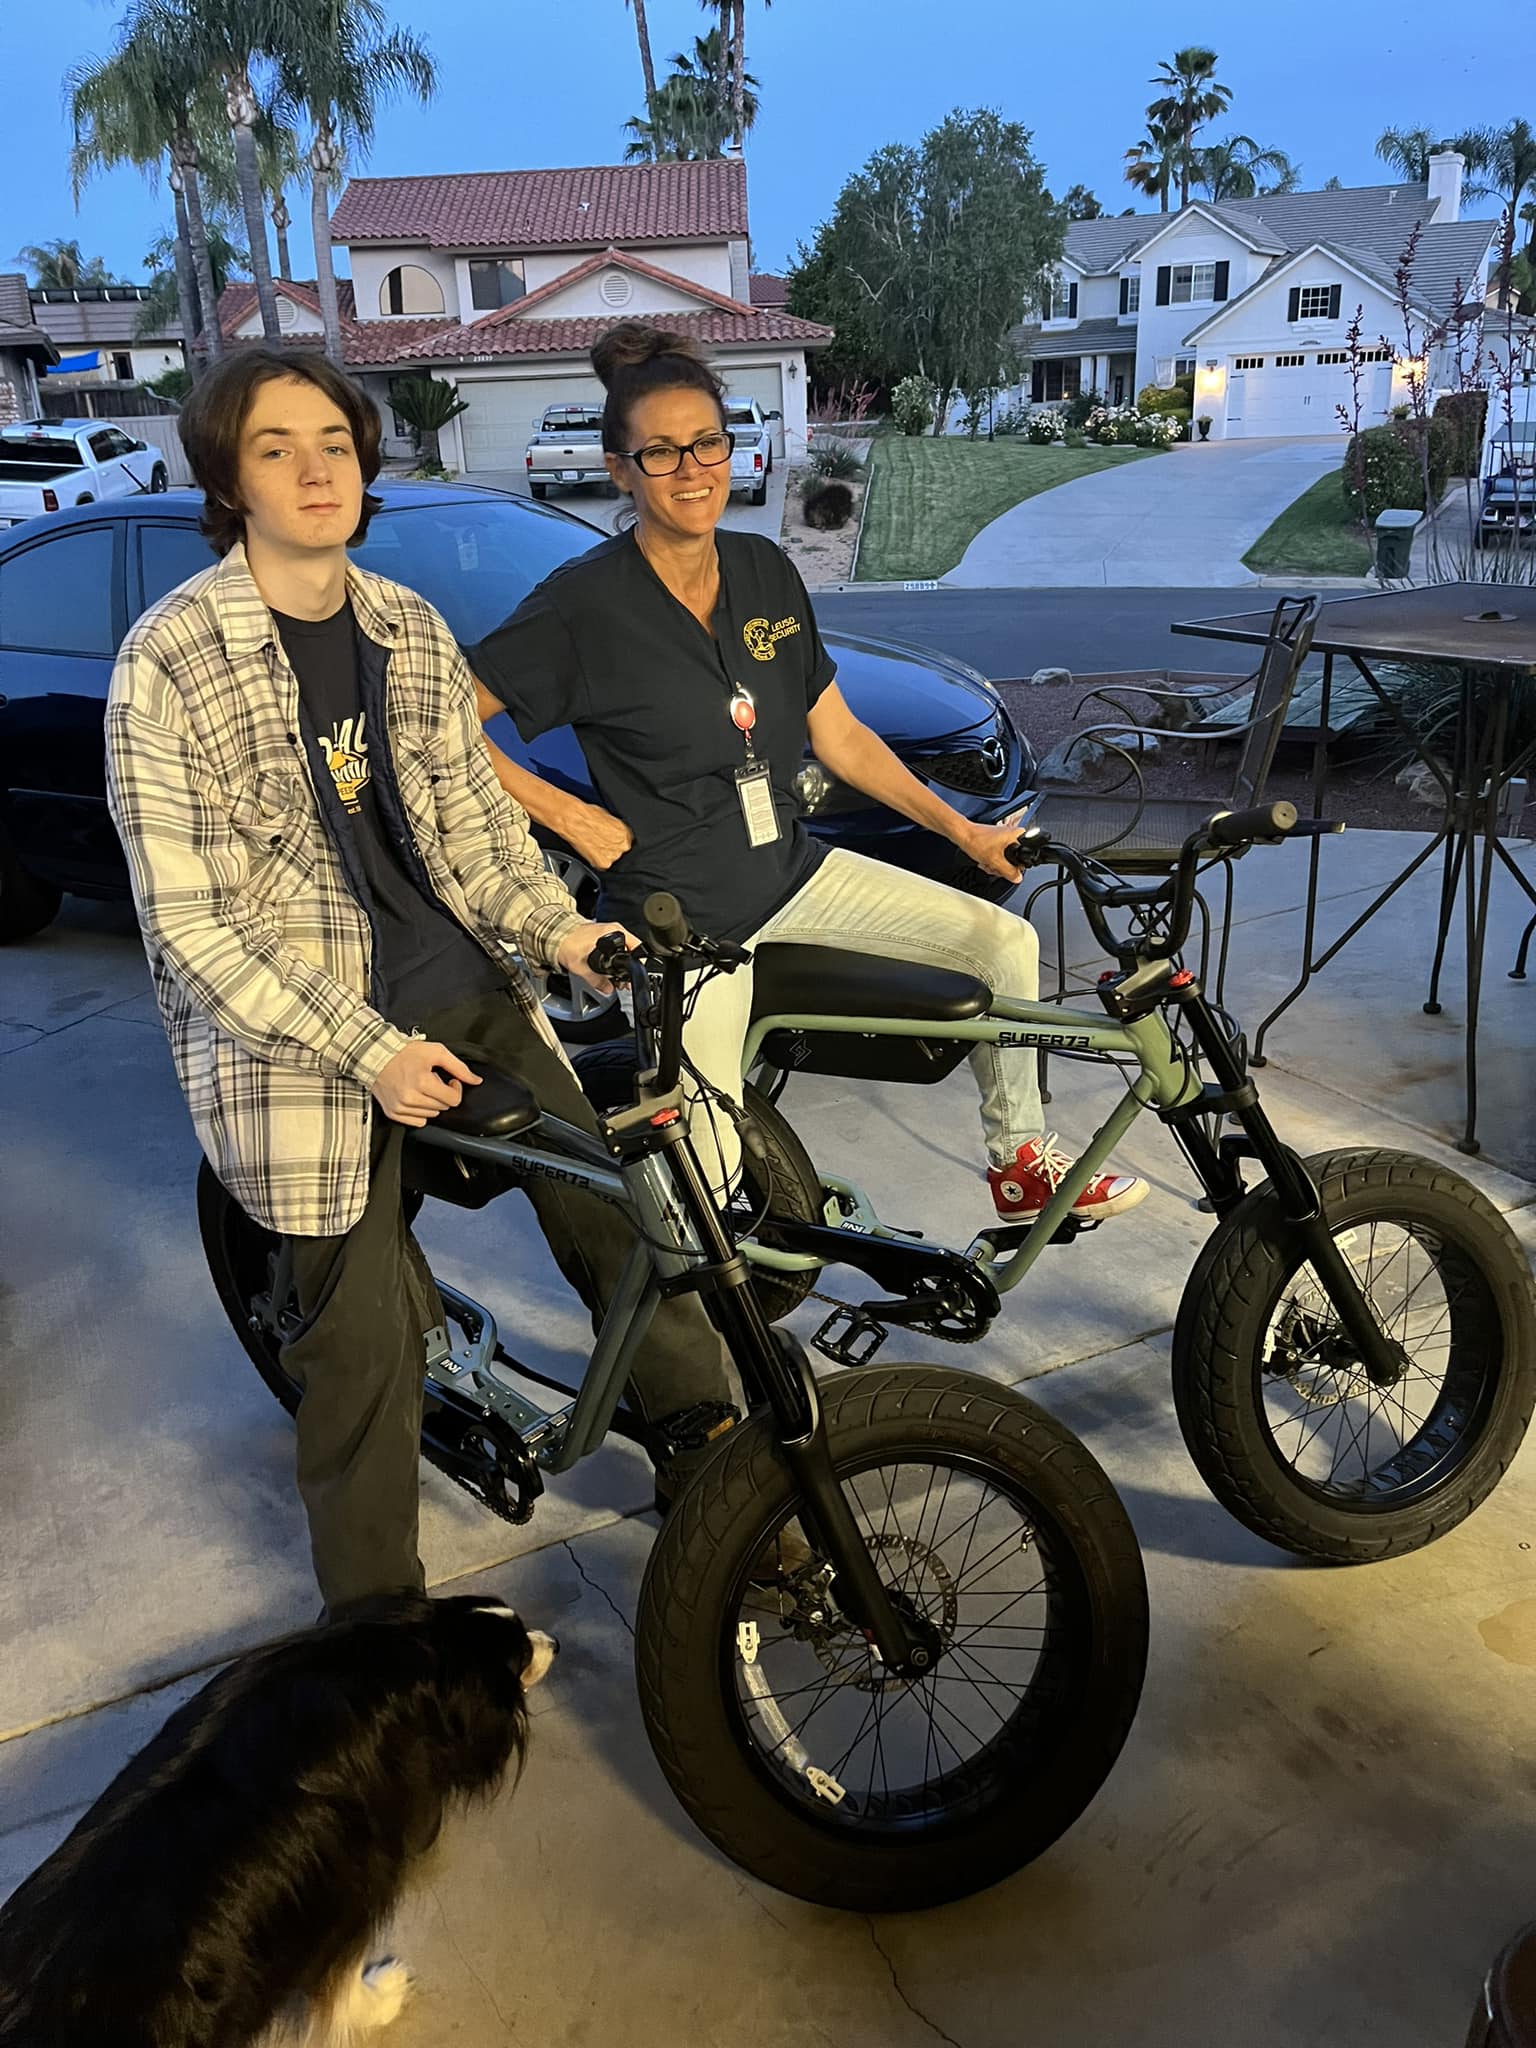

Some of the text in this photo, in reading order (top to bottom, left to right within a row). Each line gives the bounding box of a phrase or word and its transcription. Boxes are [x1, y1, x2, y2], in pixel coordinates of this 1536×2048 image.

[768, 623, 801, 641] SECURITY
[771, 616, 795, 632] LEUSD
[999, 1031, 1091, 1048] SUPER73
[512, 1155, 590, 1189] SUPER73
